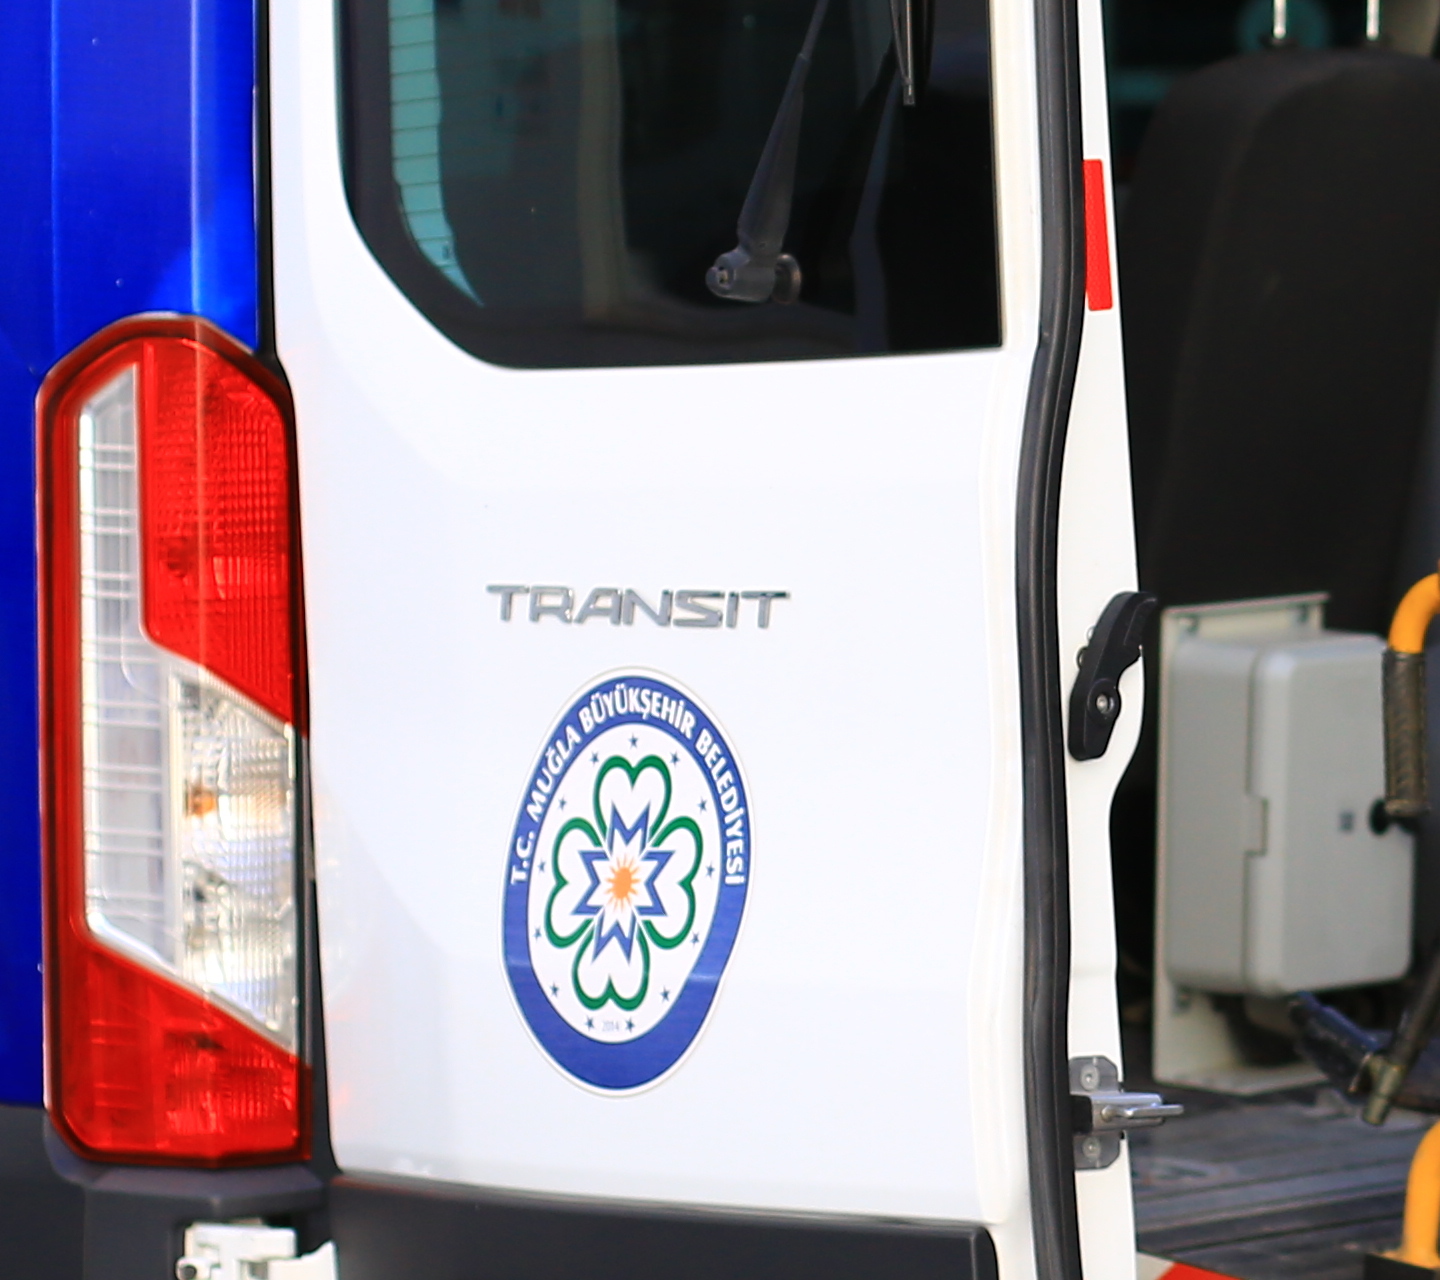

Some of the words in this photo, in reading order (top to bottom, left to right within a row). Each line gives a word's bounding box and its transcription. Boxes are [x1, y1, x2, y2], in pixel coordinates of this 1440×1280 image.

[486, 584, 790, 629] TRANSIT
[510, 831, 535, 885] T.C.
[526, 724, 582, 822] MUĞLA
[578, 683, 697, 740] BÜYÜKŞEHİR
[695, 728, 746, 885] BELEDİYESİ
